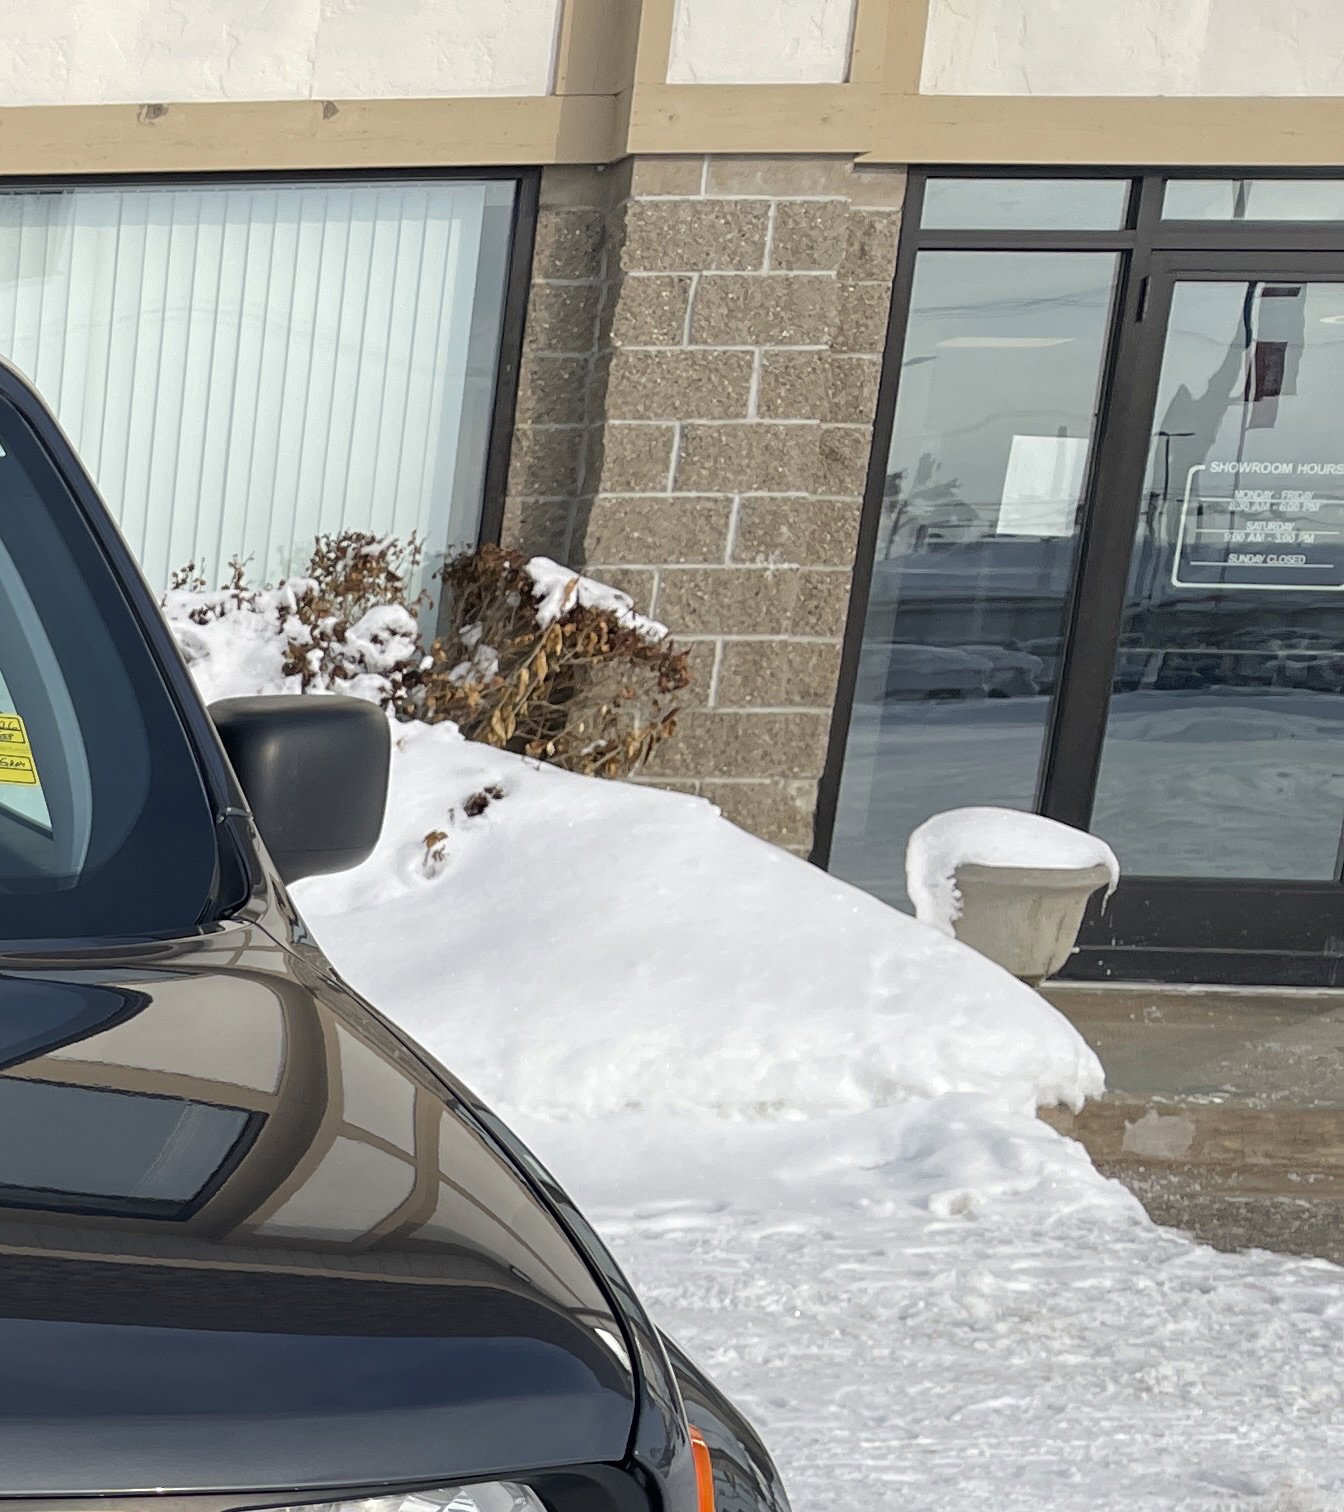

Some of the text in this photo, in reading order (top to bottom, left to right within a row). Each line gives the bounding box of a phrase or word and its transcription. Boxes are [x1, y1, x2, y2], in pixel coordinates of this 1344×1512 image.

[1209, 461, 1344, 475] SHOWROOM HOURS
[1234, 489, 1275, 501] MONDAY
[1281, 490, 1315, 501] FRIDAY
[1246, 521, 1295, 532] SATURDAY
[1228, 553, 1306, 565] SUNDAY CLOSED
